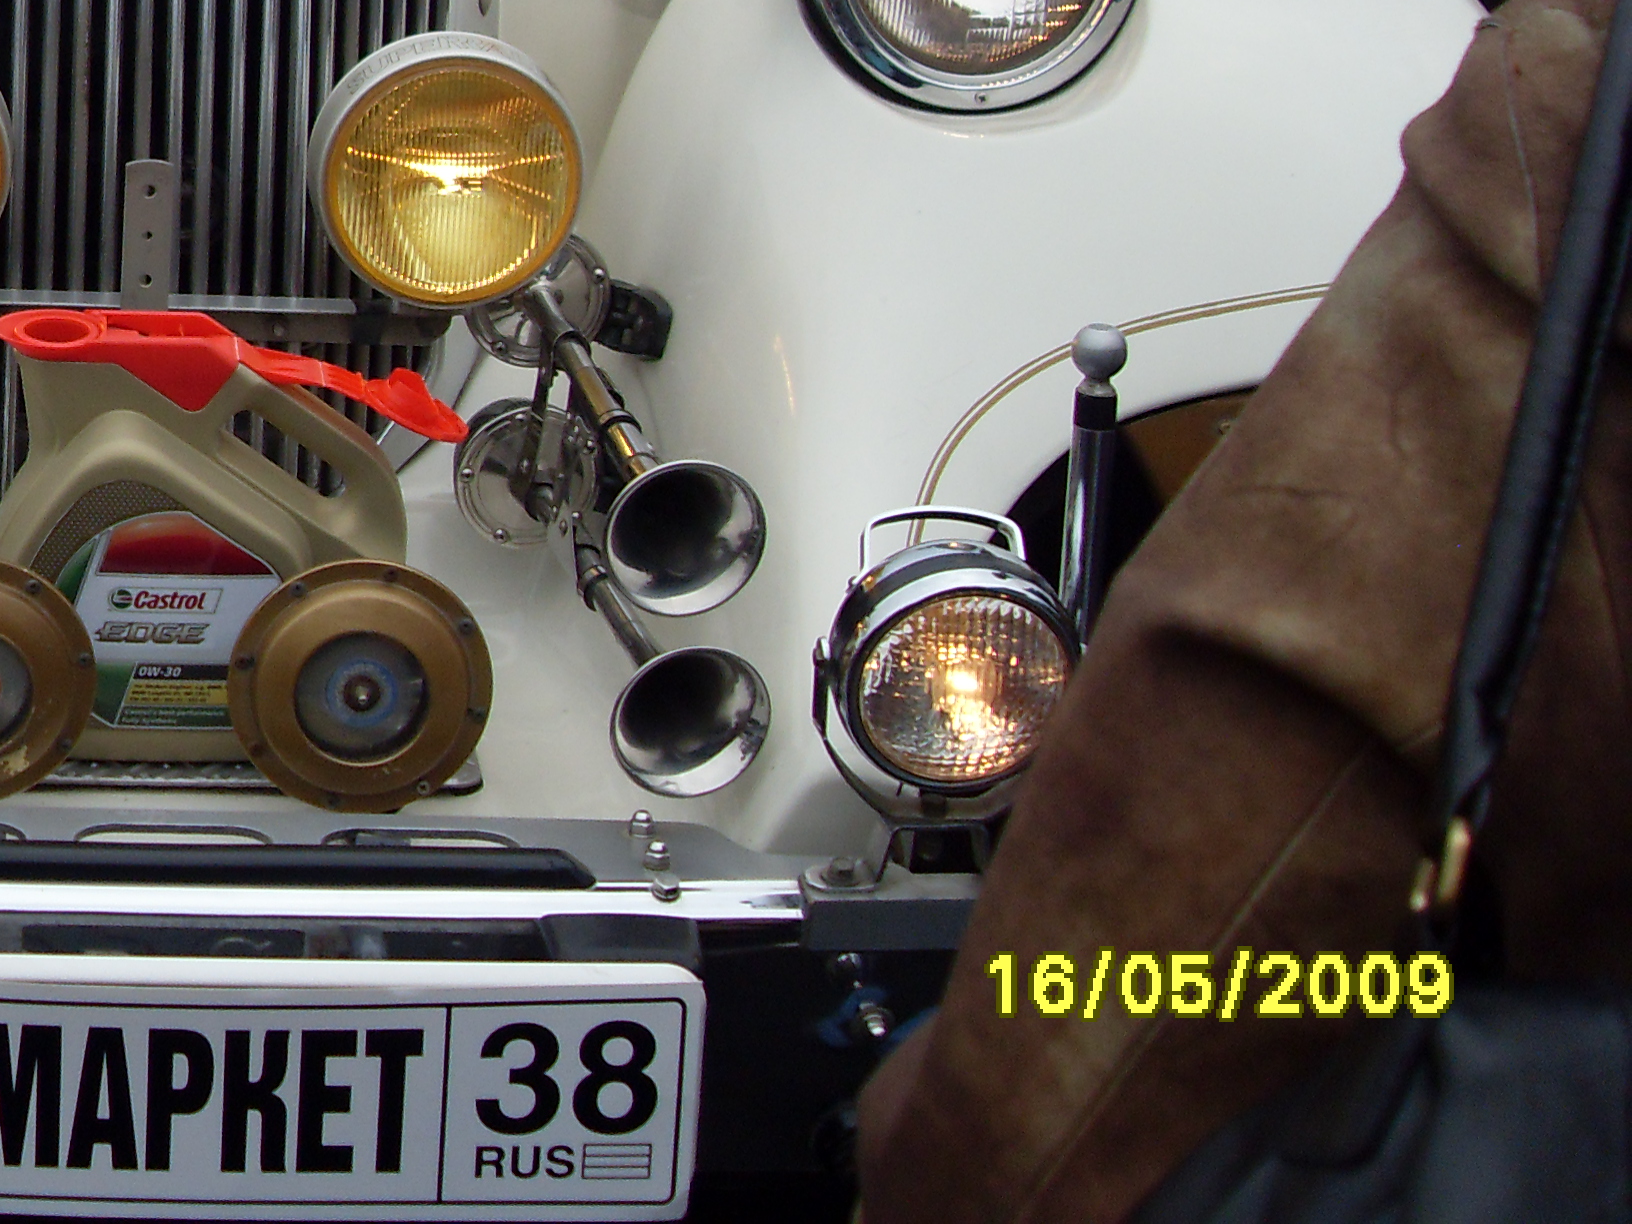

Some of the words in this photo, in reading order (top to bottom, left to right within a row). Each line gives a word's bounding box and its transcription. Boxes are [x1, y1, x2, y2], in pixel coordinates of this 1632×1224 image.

[133, 590, 206, 610] Castrol
[95, 621, 210, 644] EDGE
[138, 666, 182, 677] 0W-30
[475, 1019, 658, 1136] 38
[474, 1144, 574, 1179] RUS
